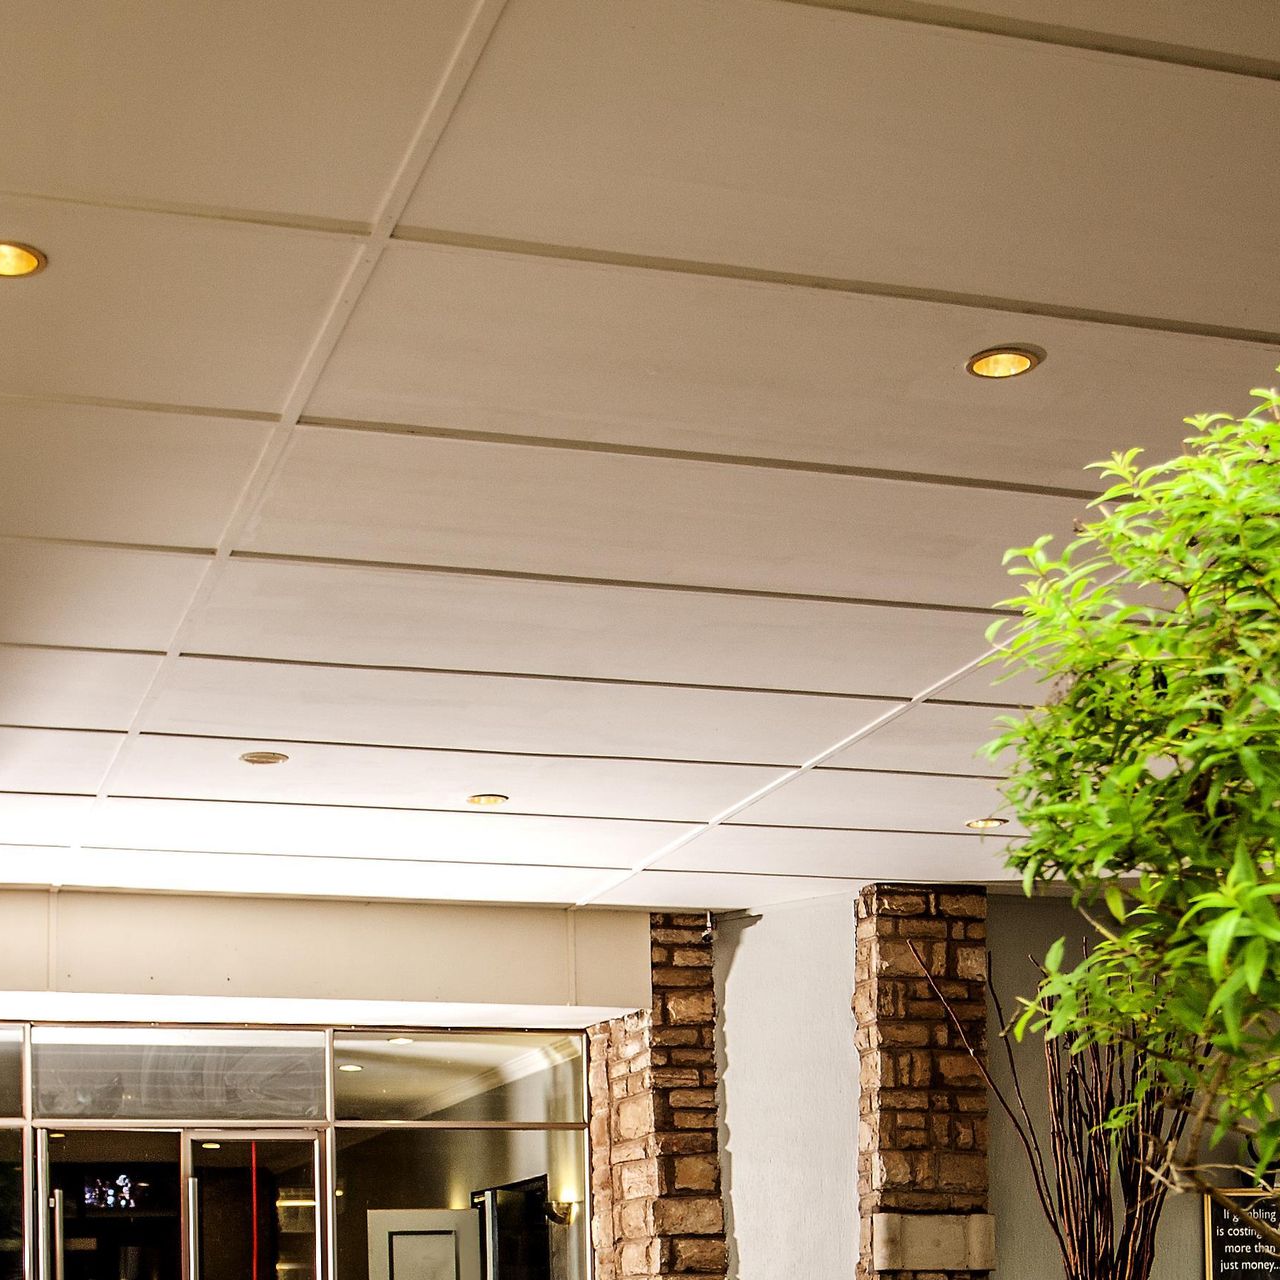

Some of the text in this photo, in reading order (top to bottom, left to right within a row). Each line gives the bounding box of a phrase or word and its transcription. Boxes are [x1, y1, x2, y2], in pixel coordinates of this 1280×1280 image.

[1232, 1208, 1276, 1223] gbling
[1216, 1225, 1224, 1236] is
[1224, 1242, 1276, 1253] more than
[1220, 1260, 1239, 1273] just
